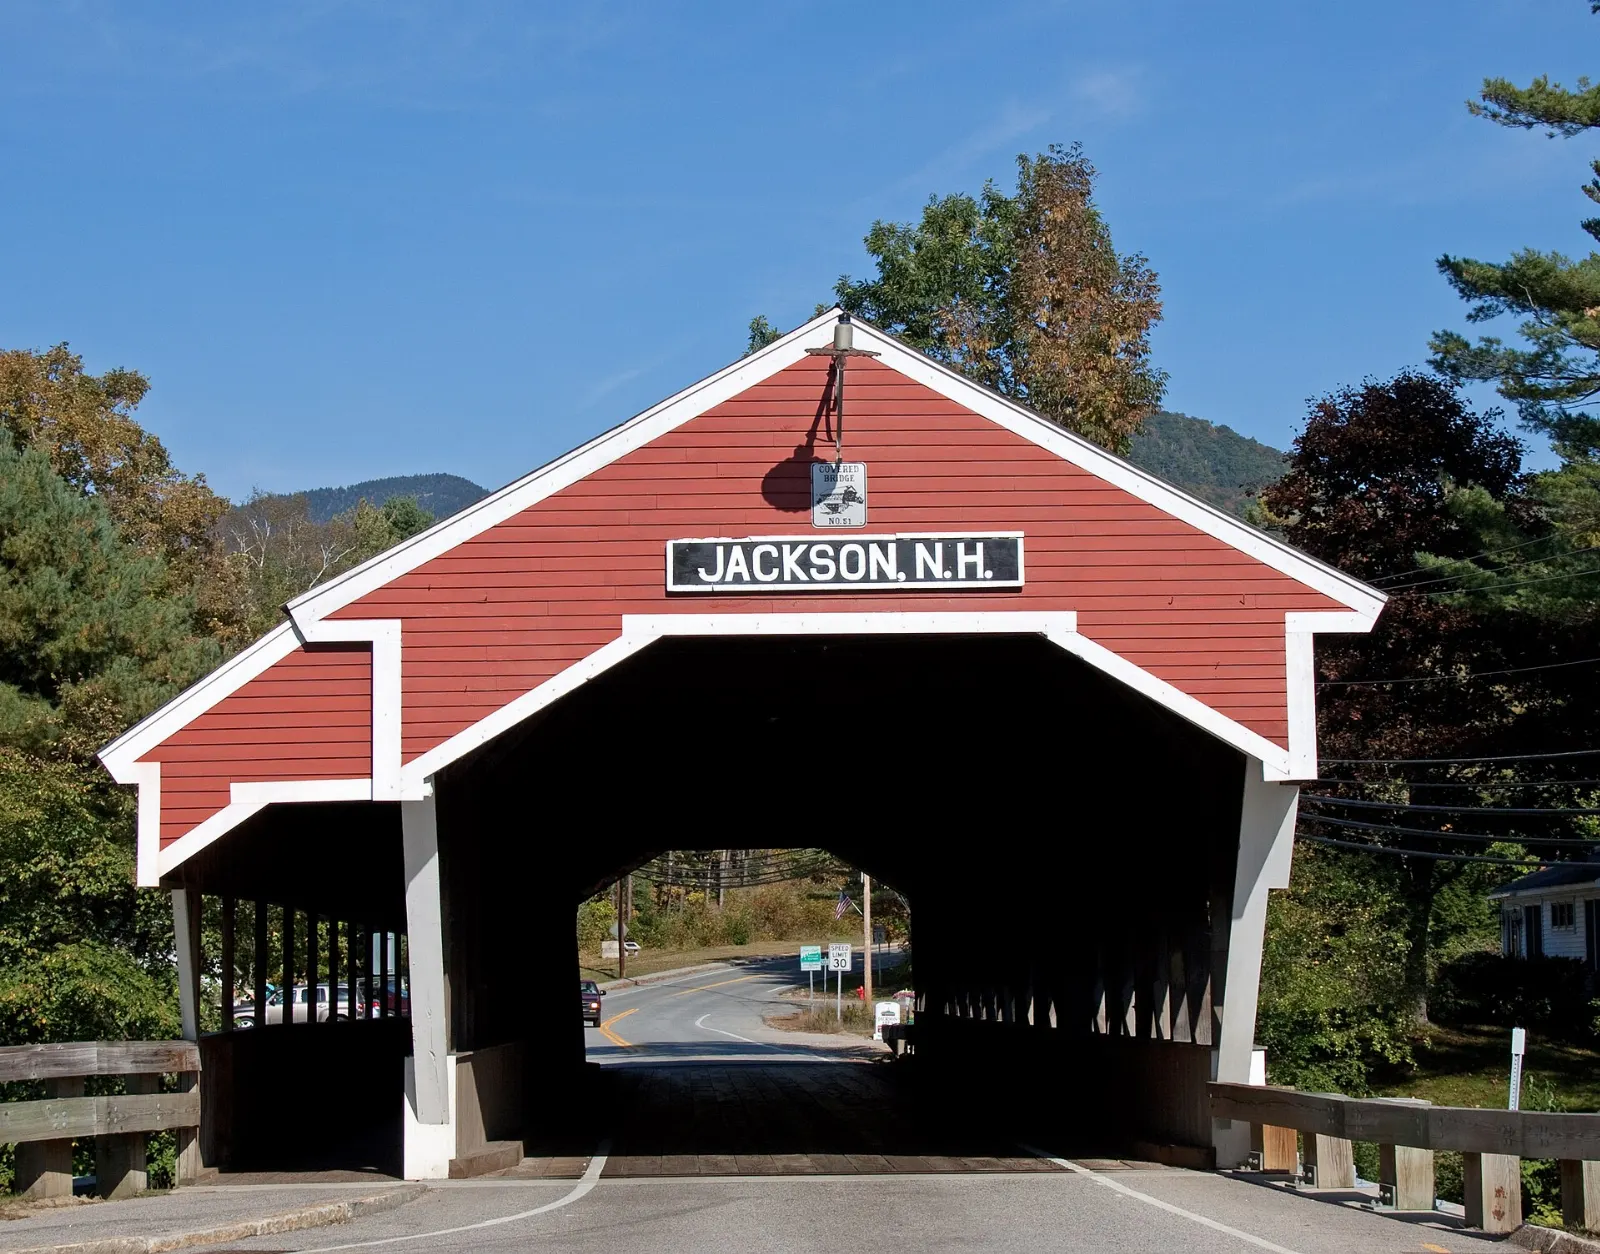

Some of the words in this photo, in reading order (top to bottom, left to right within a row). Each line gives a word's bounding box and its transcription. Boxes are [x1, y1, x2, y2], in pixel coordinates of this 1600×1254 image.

[819, 465, 859, 473] COVERED
[824, 474, 855, 482] BRIDGE
[915, 542, 993, 579] N.H.
[833, 958, 847, 968] 30
